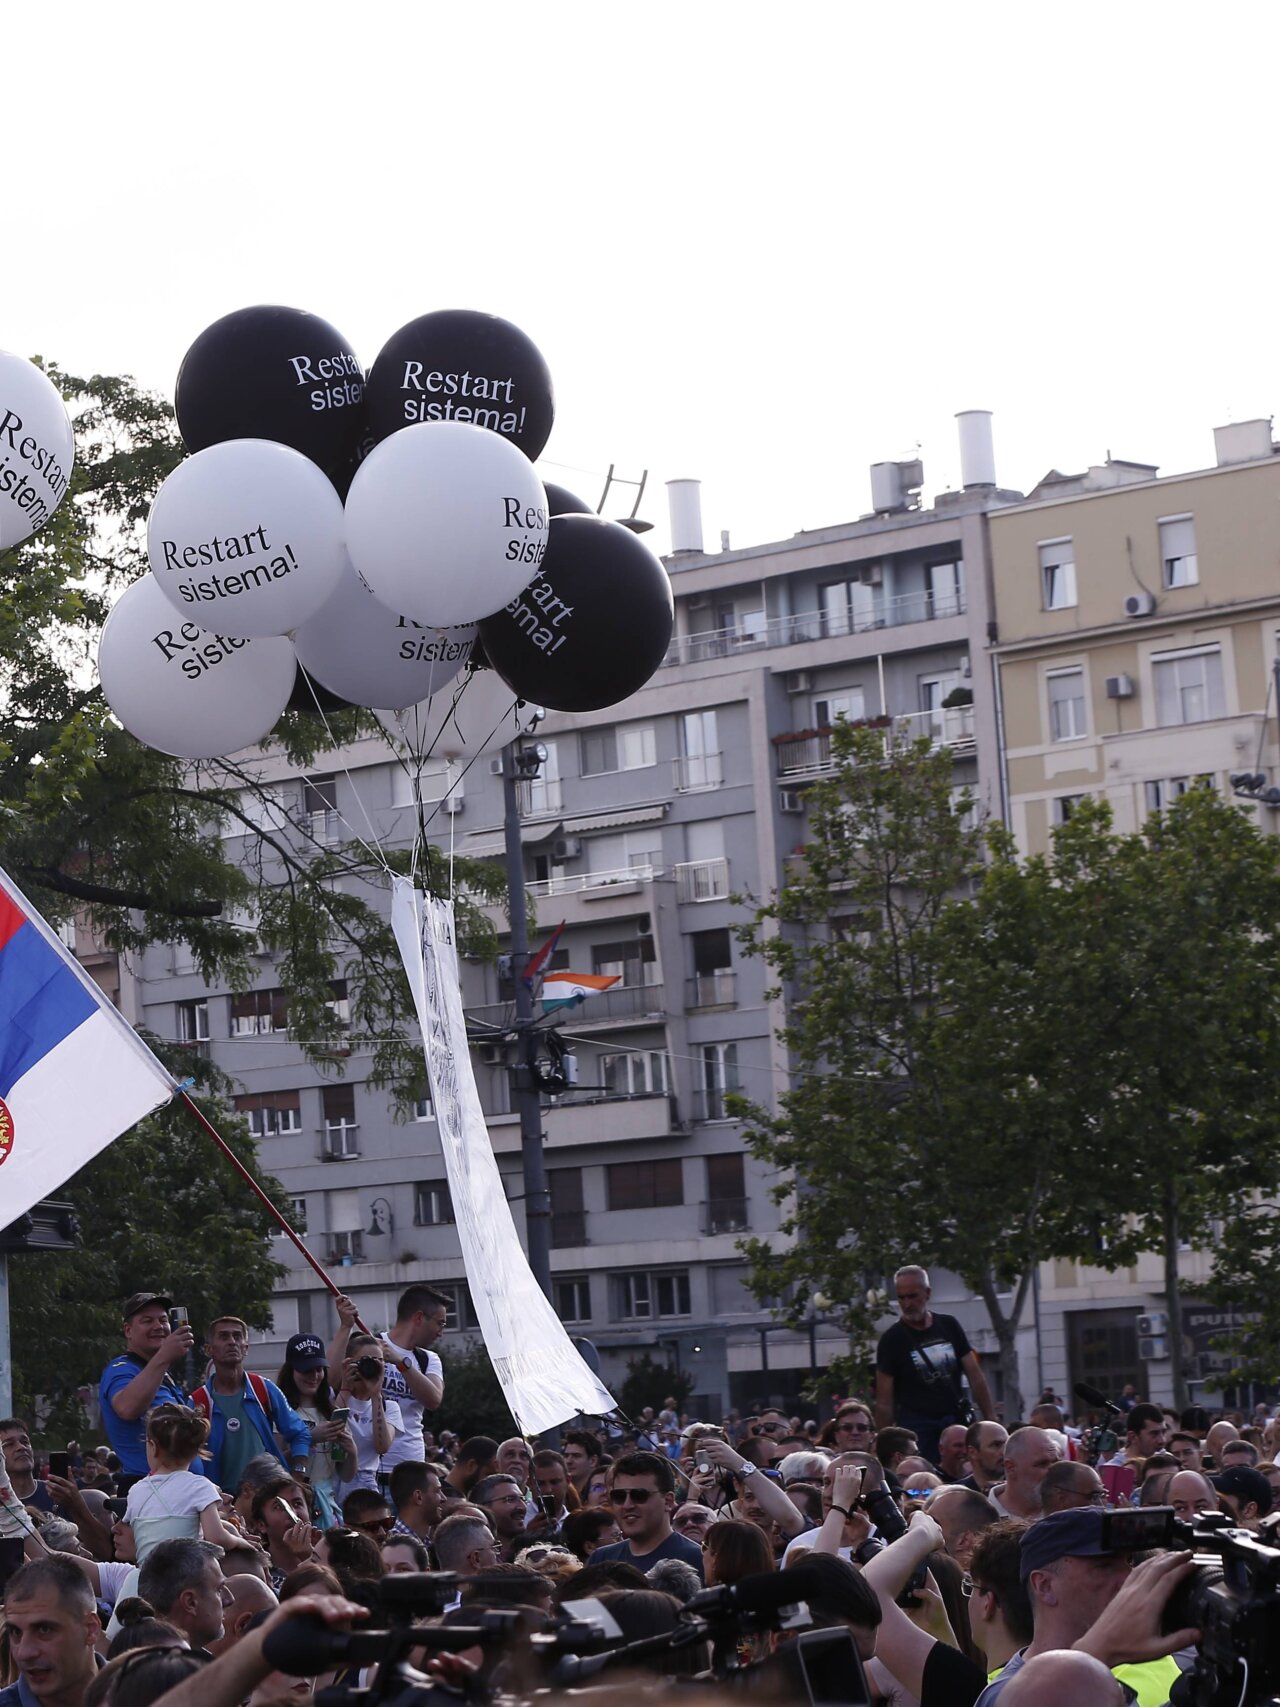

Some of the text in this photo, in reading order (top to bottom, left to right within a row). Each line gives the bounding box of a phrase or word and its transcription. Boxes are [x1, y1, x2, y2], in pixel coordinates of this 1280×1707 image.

[400, 361, 516, 404] Restart
[404, 394, 527, 434] sistema!
[161, 524, 272, 570] Restart
[178, 544, 299, 603] sistema!
